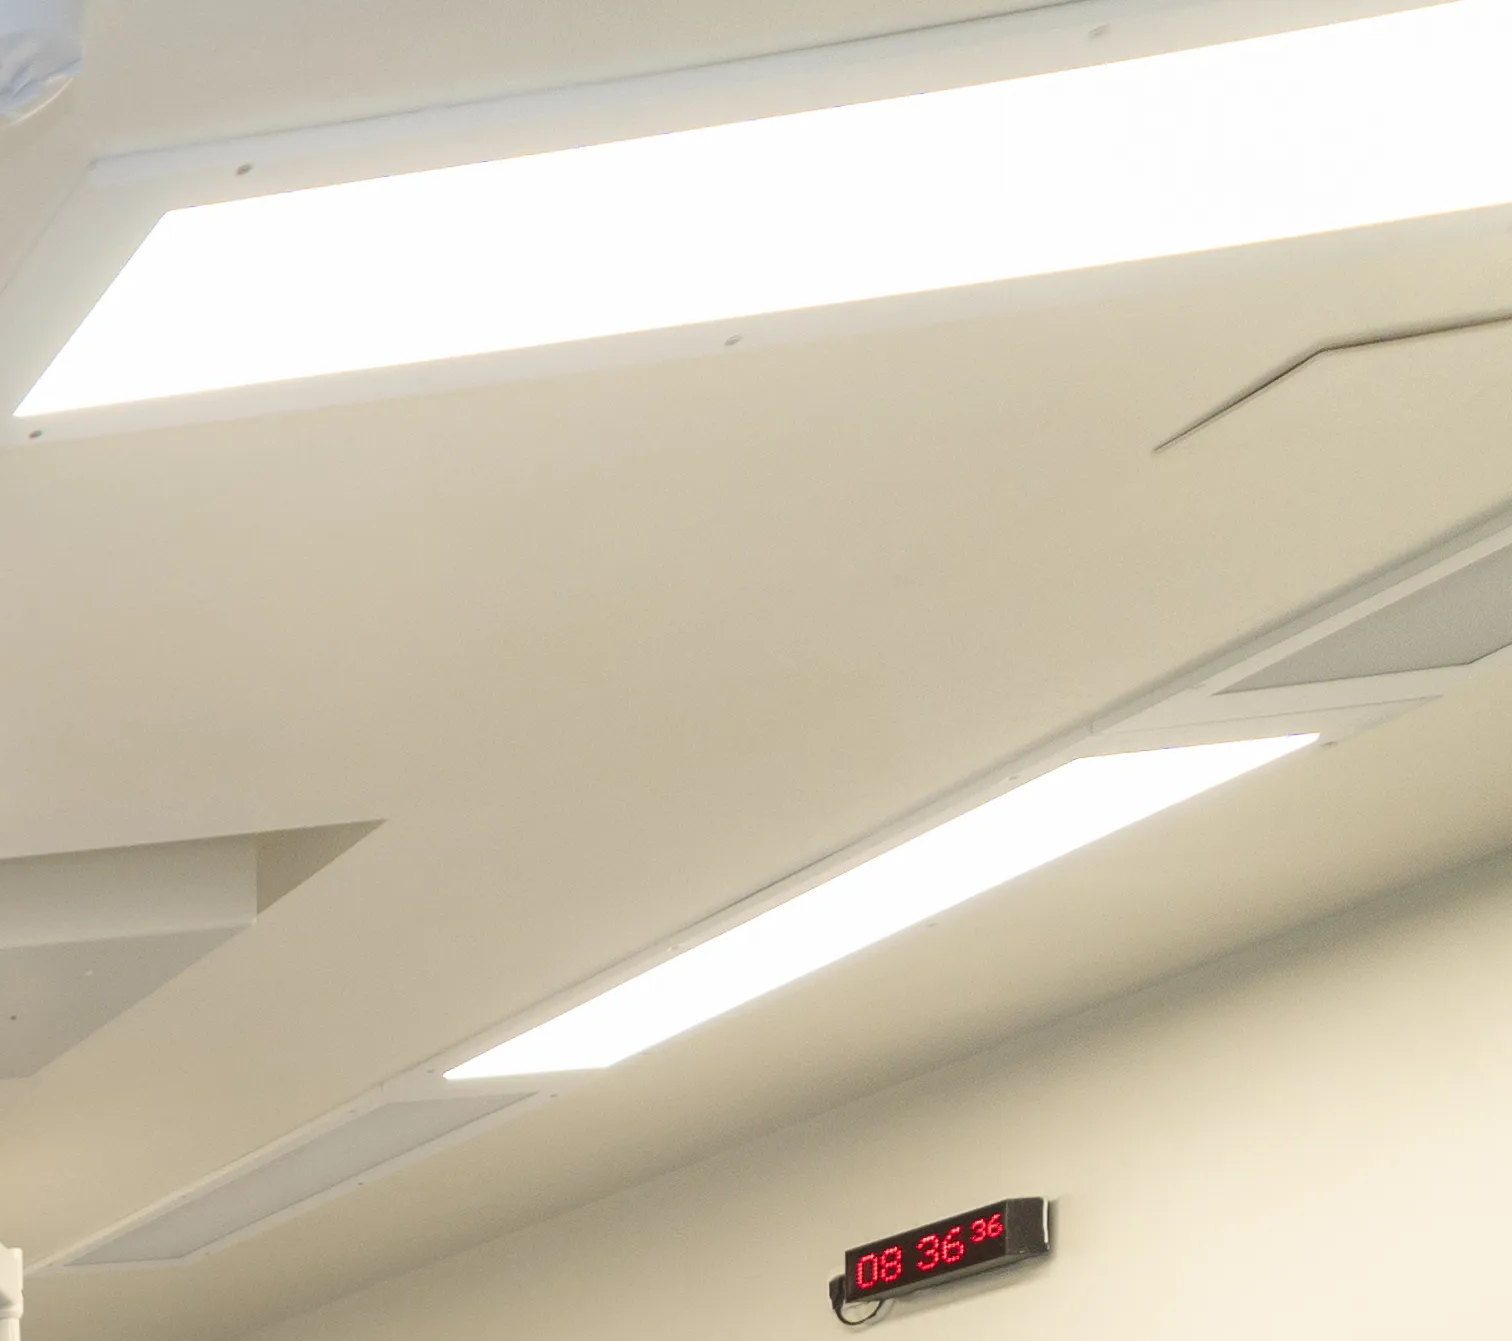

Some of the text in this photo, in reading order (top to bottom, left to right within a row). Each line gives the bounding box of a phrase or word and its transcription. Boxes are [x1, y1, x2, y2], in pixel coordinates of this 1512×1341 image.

[855, 1213, 1003, 1290] 08 36 36
